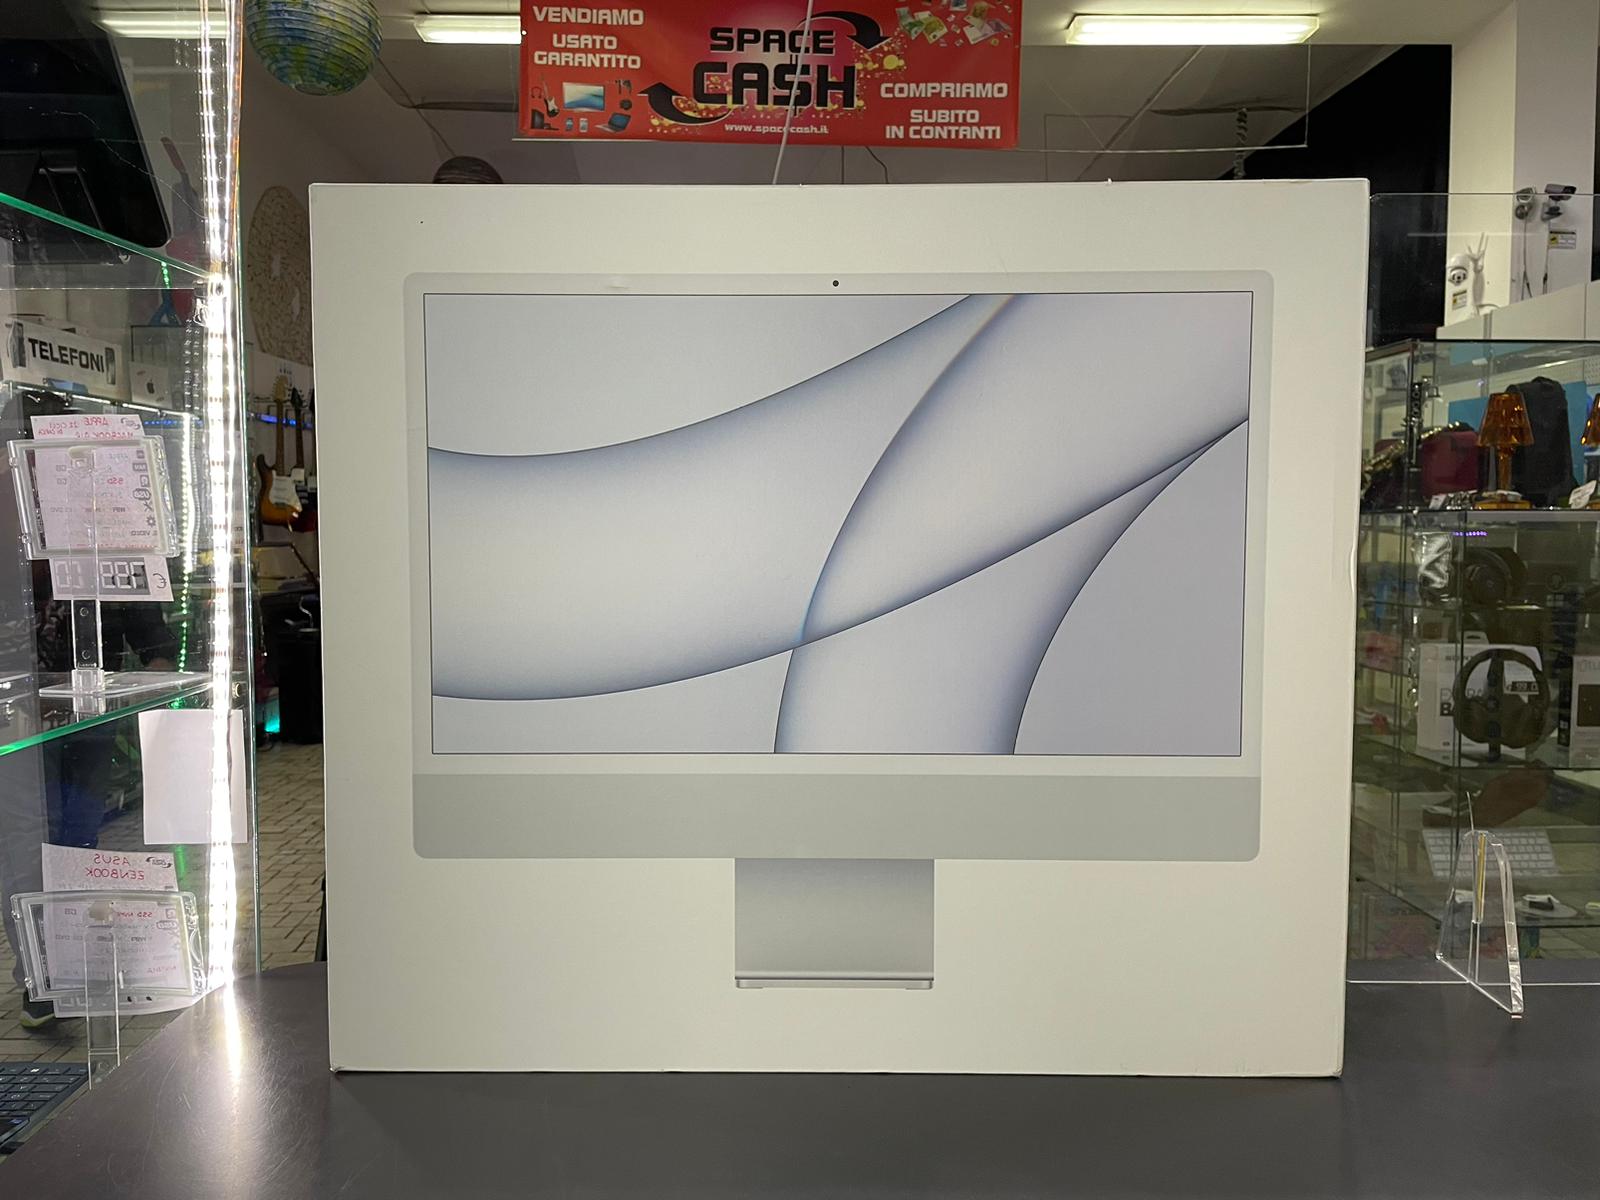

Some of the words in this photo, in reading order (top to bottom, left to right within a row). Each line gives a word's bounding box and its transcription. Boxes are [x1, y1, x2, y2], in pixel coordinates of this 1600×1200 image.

[532, 6, 644, 26] VENDIAMO
[552, 33, 618, 50] USATO
[710, 26, 836, 55] SPACE
[533, 51, 641, 69] GARANTITO
[692, 59, 857, 111] CASH
[880, 83, 1008, 98] COMPRIAMO
[910, 109, 980, 123] SUBITO
[885, 125, 904, 139] IN
[909, 125, 1001, 140] CONTANTI
[28, 337, 105, 373] TELEFONI
